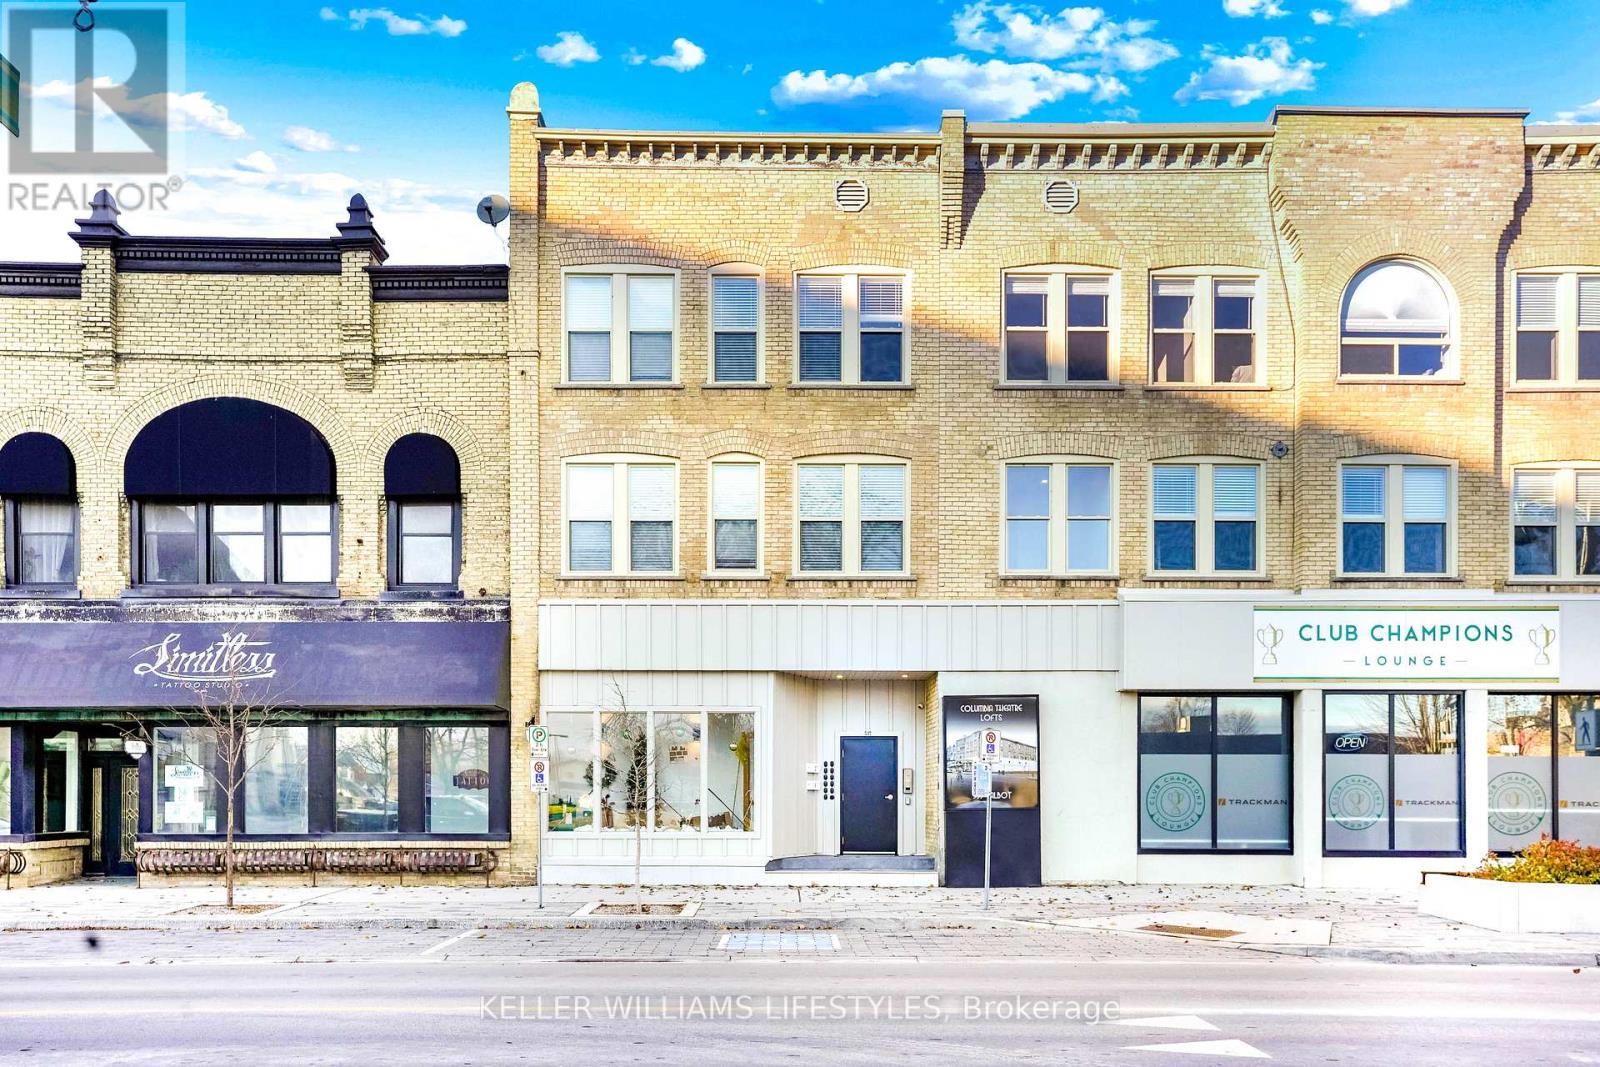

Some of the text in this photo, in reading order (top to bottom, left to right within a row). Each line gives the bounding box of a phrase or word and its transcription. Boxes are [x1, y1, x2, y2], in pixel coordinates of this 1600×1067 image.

[1299, 624, 1514, 642] CLUB CHAMPIONS
[129, 632, 276, 681] Limitless
[1364, 655, 1447, 666] LOUNGE
[160, 681, 243, 689] TATTOO STUDO
[980, 713, 1003, 722] LOFTS
[1335, 737, 1366, 748] OPEN
[1229, 798, 1288, 806] TRACKMAN
[1156, 817, 1196, 830] LOUNGE
